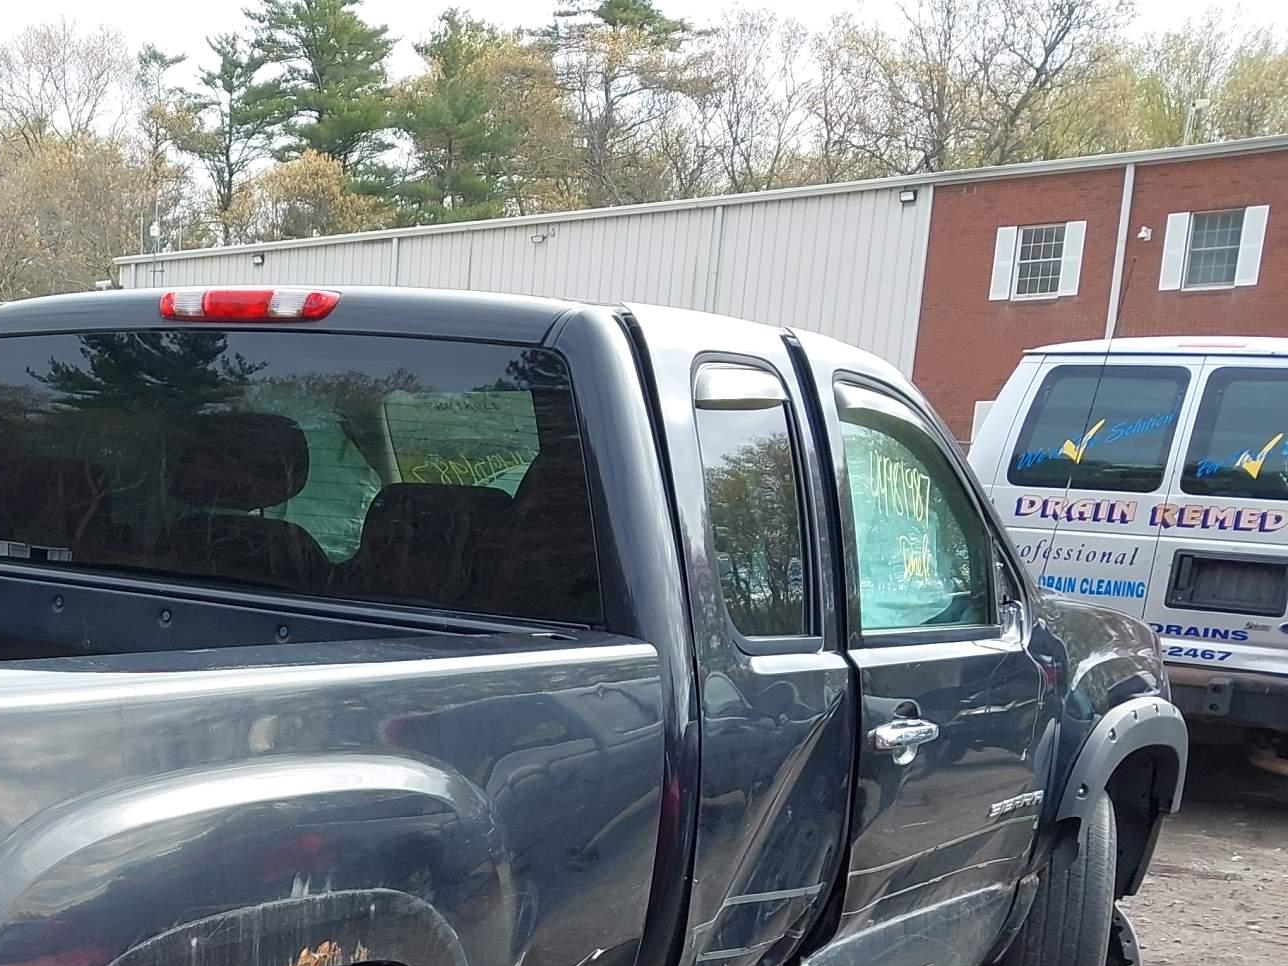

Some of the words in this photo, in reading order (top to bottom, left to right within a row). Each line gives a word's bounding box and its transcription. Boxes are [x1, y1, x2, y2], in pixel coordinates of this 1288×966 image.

[1105, 412, 1179, 443] Solution
[1015, 494, 1138, 523] DRAIN
[1149, 503, 1288, 532] REMED
[1016, 538, 1140, 566] ofessional
[1038, 575, 1076, 594] DRAIN
[1079, 577, 1146, 599] CLEANING
[1148, 622, 1249, 641] DRAINS
[1162, 645, 1233, 661] -2467
[988, 789, 1044, 818] SIERRA
